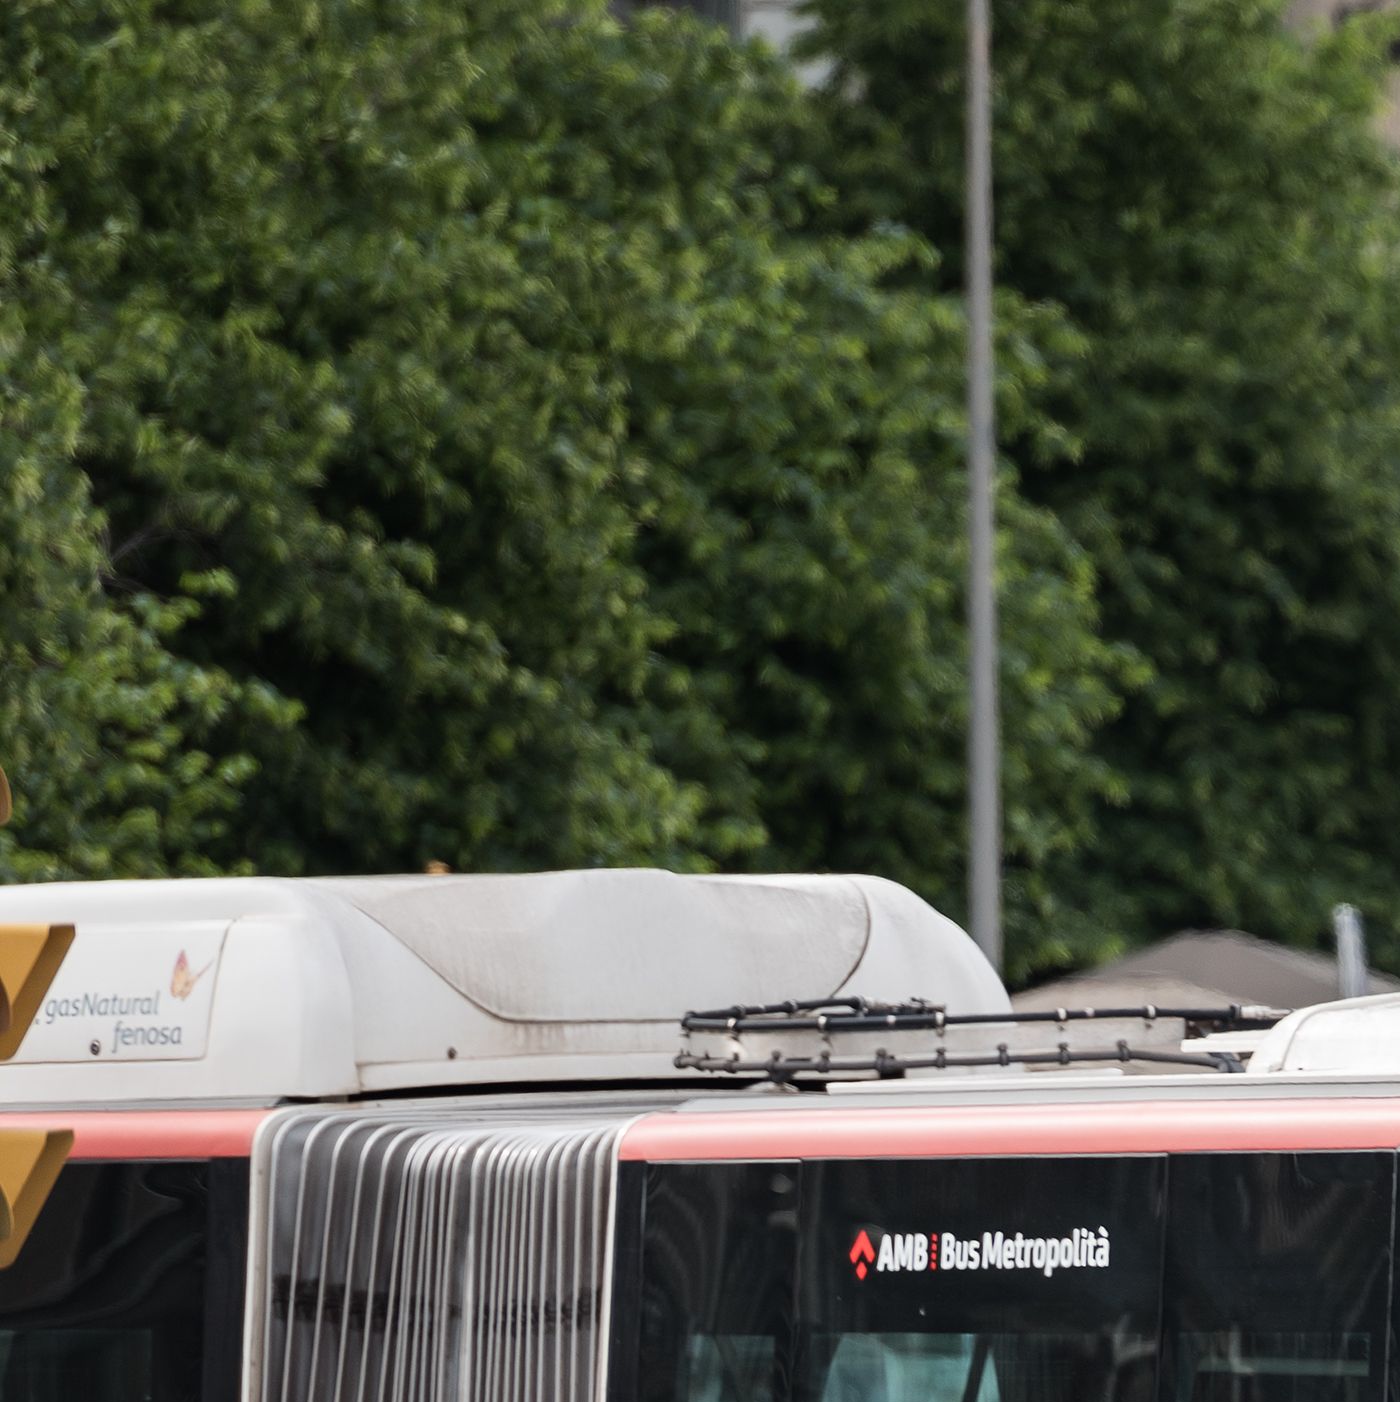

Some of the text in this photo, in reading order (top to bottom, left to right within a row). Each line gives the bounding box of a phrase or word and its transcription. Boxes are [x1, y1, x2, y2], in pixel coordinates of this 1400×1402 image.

[111, 1020, 182, 1053] fenosa
[876, 1225, 1109, 1277] AMB Bus Metropolità
